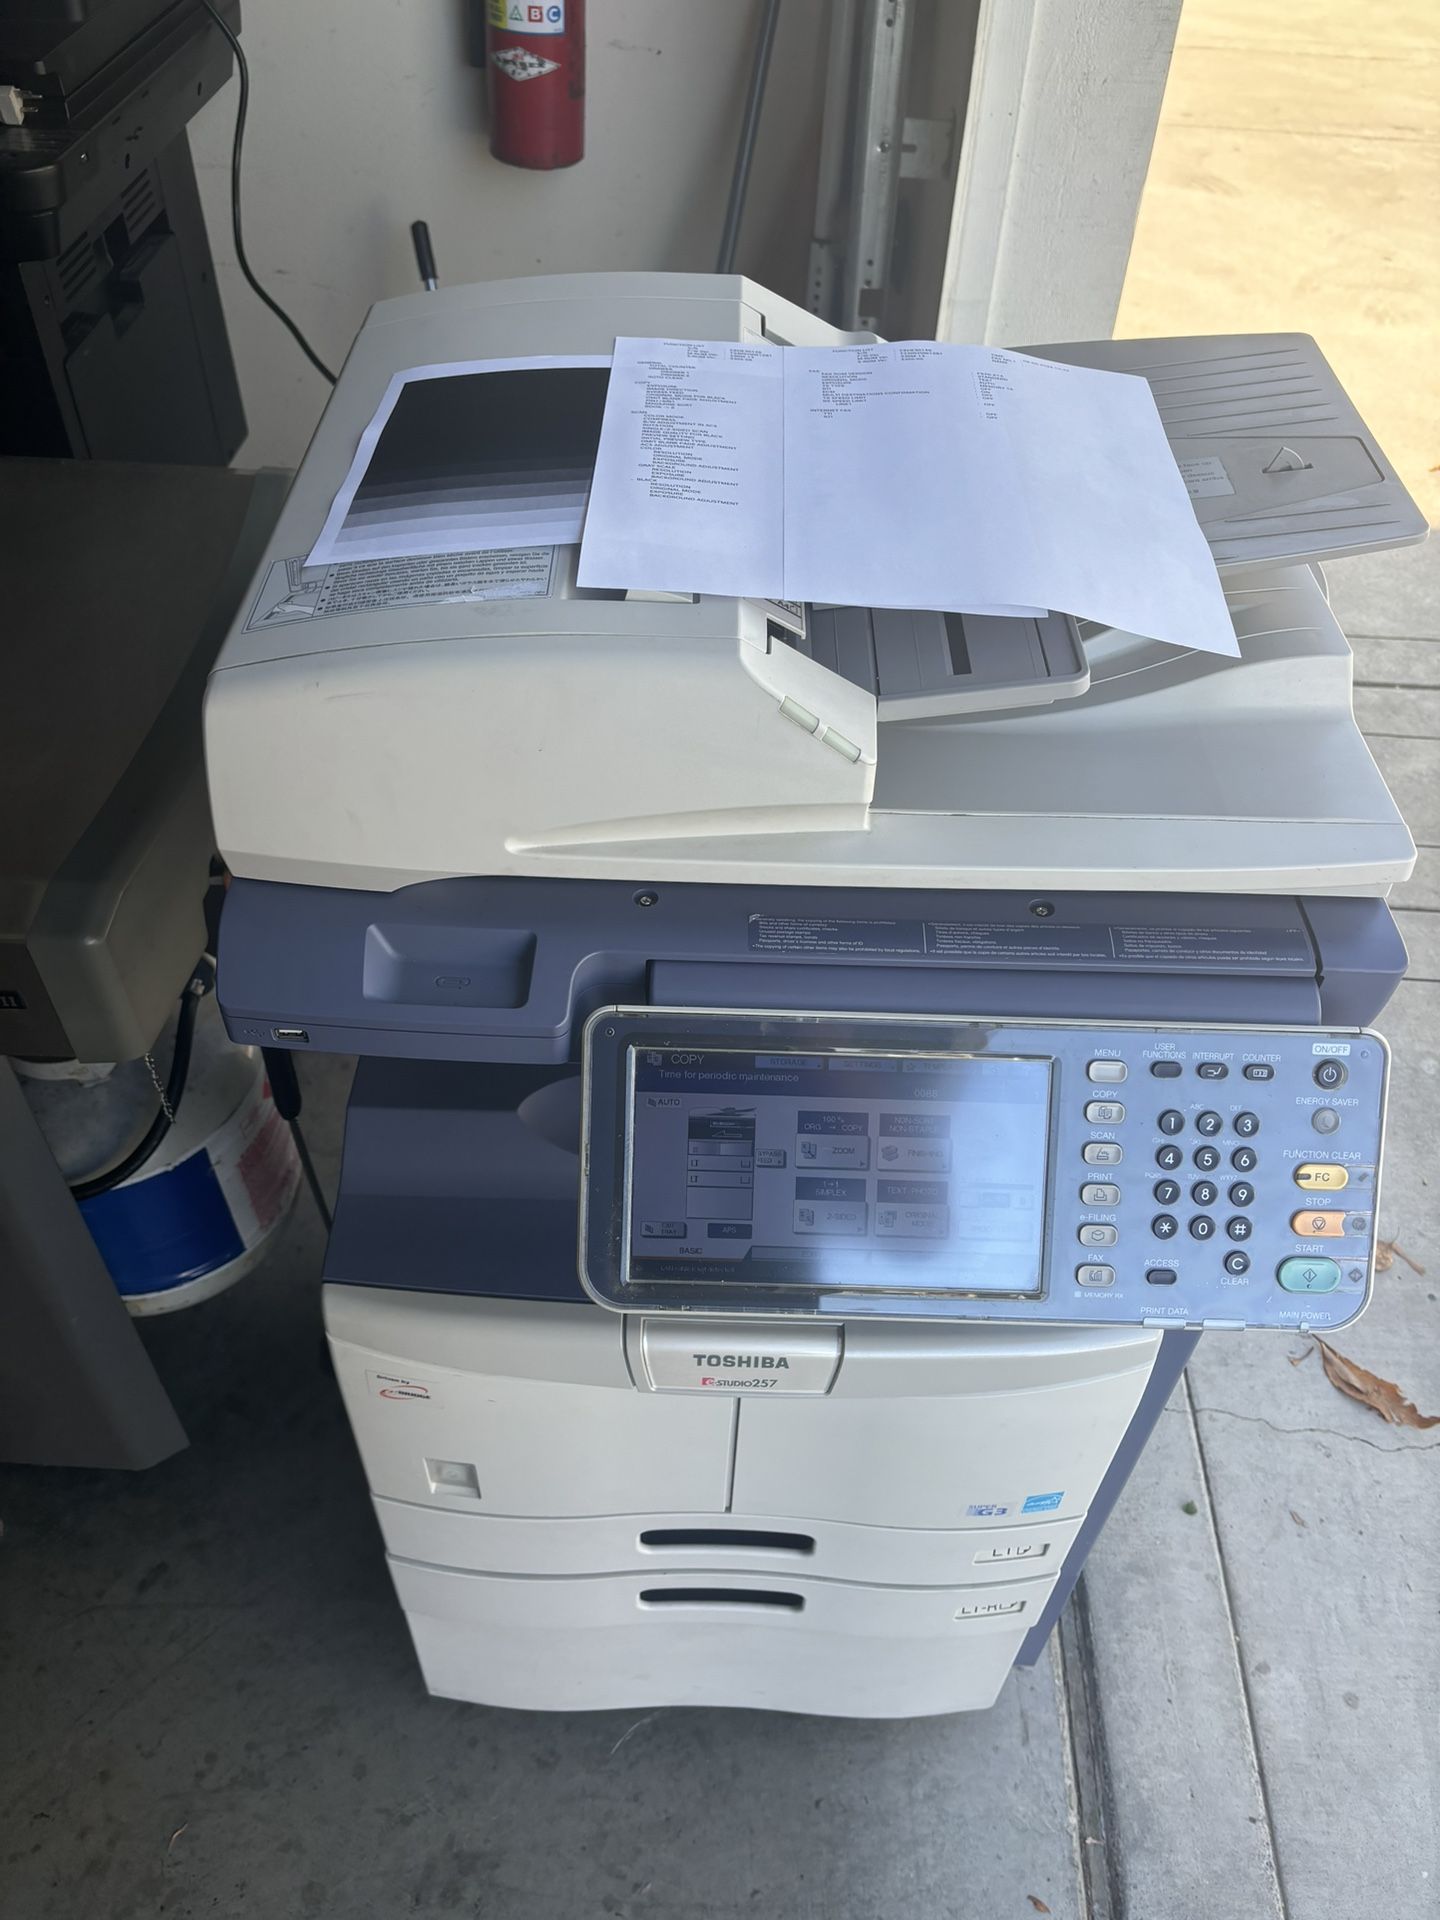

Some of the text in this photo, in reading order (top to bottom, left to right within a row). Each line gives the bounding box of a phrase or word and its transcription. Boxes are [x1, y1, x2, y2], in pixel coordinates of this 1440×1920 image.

[697, 498, 739, 506] ADJUSTMENT
[1154, 1042, 1176, 1050] USER
[1314, 1046, 1348, 1054] ON/OFF
[1094, 1049, 1121, 1057] MENU
[1142, 1050, 1187, 1059] FUNCTIONS
[1192, 1052, 1235, 1061] INTERRUPT
[1242, 1053, 1282, 1062] COUNTER
[671, 1053, 704, 1065] COPY
[658, 1070, 800, 1082] Time for periodic maintenance
[1092, 1090, 1119, 1098] COPY
[657, 1098, 680, 1107] AUTO
[1296, 1097, 1359, 1106] ENERGY SAVER
[842, 1124, 864, 1133] COPY
[1169, 1117, 1253, 1132] 1 2 3
[1090, 1132, 1115, 1140] SCAN
[832, 1147, 855, 1155] ZOOM
[1283, 1149, 1361, 1160] FUNCTION CLEAR
[1164, 1152, 1250, 1167] 4 5 6
[1087, 1172, 1114, 1180] PRINT
[1314, 1173, 1330, 1182] FC
[1165, 1187, 1248, 1201] 7 8 9
[1305, 1198, 1332, 1206] STOP
[1079, 1214, 1117, 1222] e-FILING
[1198, 1222, 1247, 1236] 0 #
[679, 1246, 704, 1255] BASIC
[1295, 1244, 1325, 1253] START
[1087, 1254, 1104, 1262] FAX
[1144, 1259, 1181, 1267] ACCESS
[1231, 1258, 1244, 1270] C
[1220, 1277, 1249, 1285] CLEAR
[1084, 1291, 1114, 1299] MEMORY
[1140, 1307, 1190, 1316] PRINT DATA
[1279, 1311, 1331, 1320] MAIN POWER
[693, 1354, 789, 1369] TOSHIBA
